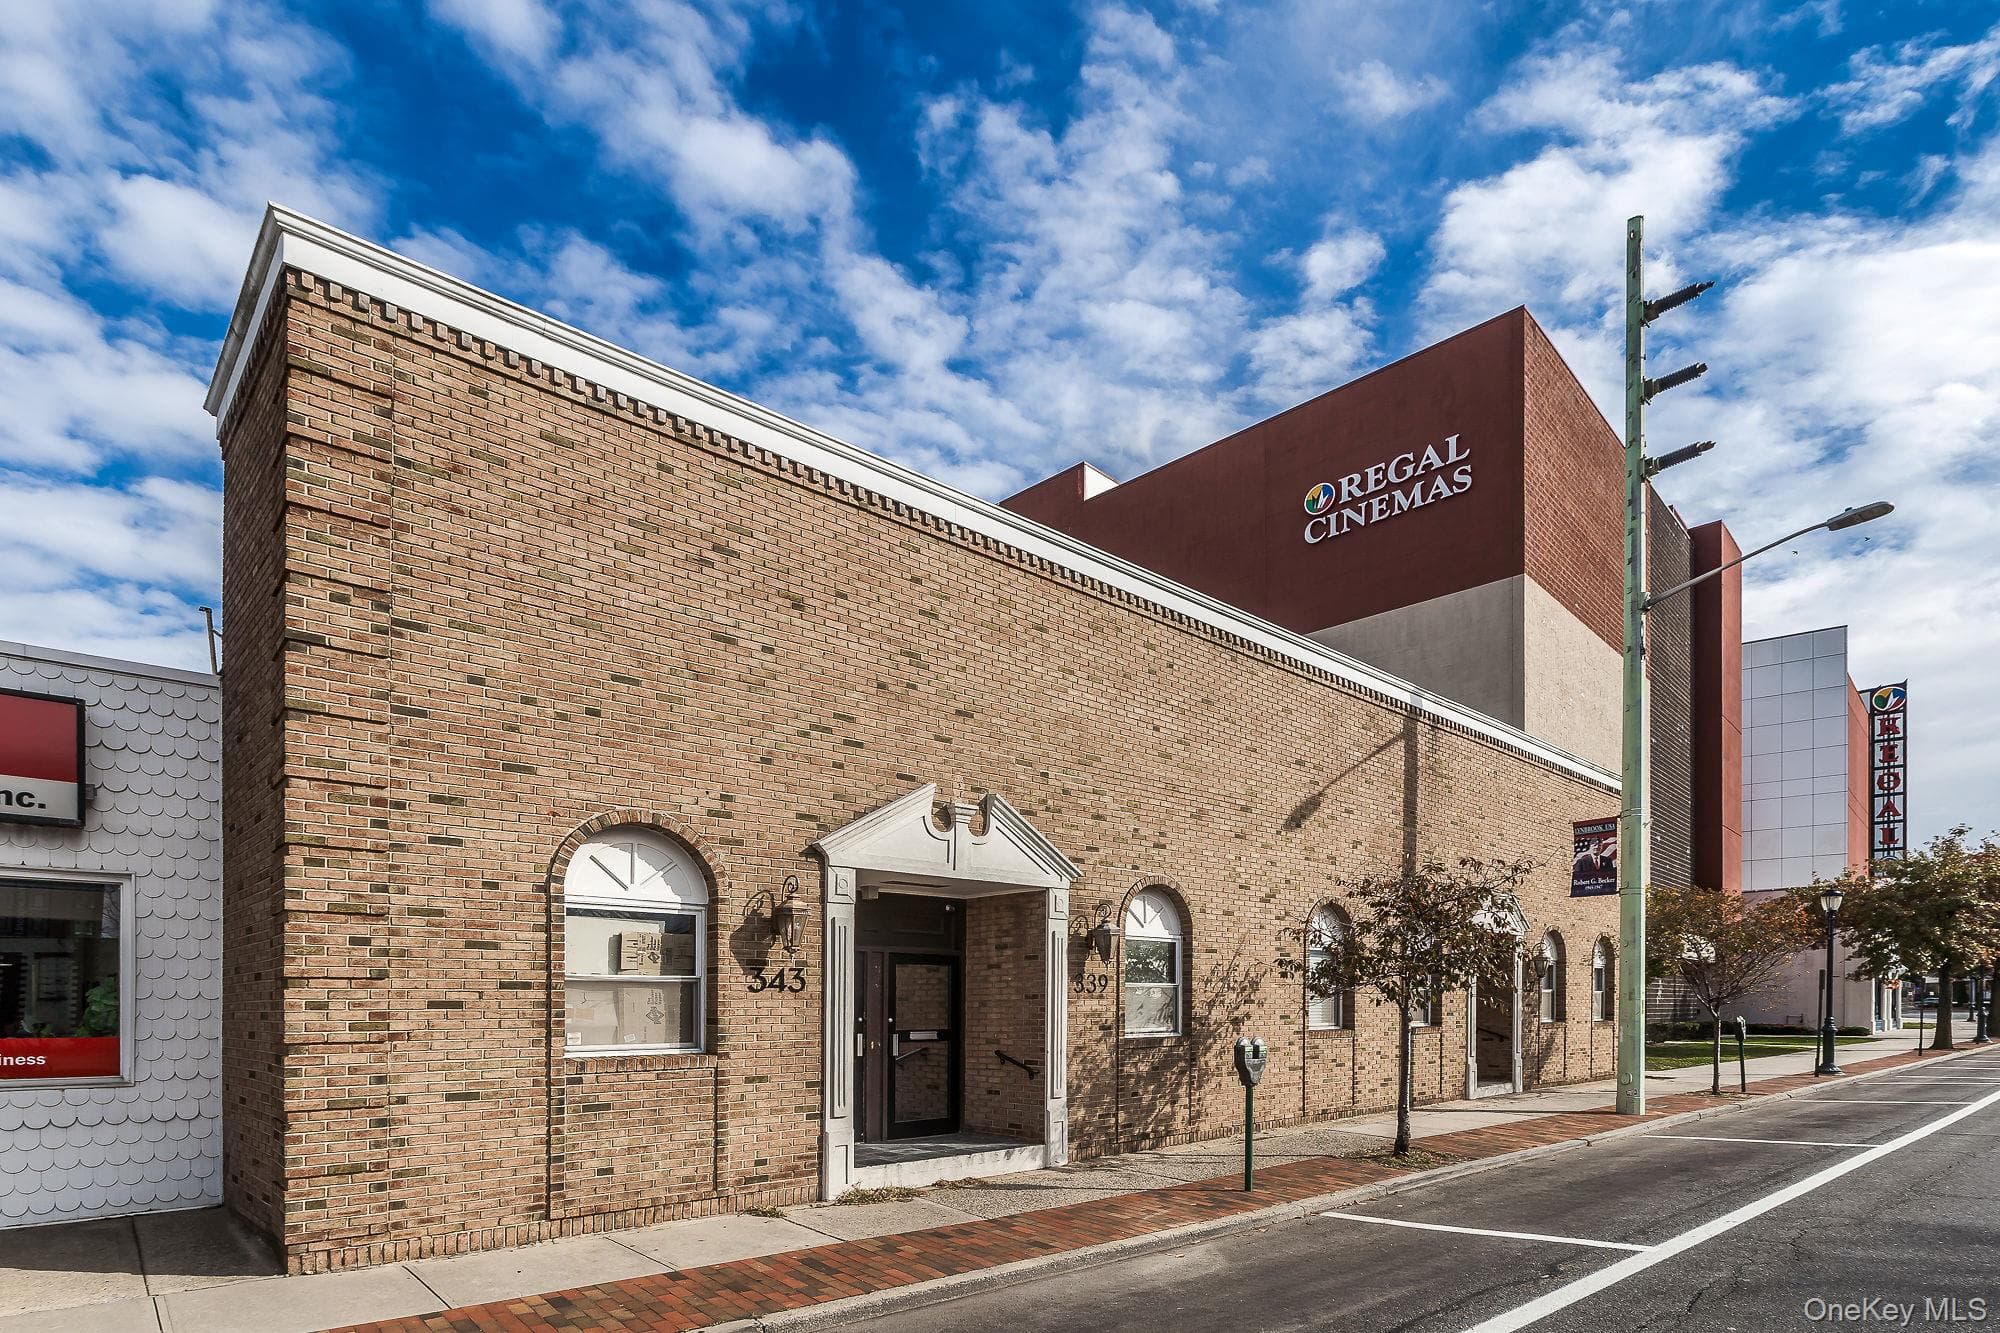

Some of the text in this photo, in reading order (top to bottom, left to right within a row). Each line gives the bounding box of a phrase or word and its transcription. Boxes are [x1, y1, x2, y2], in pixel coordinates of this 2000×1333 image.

[1338, 433, 1471, 504] REGAL
[1304, 464, 1474, 544] CINEMAS
[1598, 876, 1615, 884] Becker
[747, 967, 806, 993] 343
[1074, 973, 1108, 993] 339
